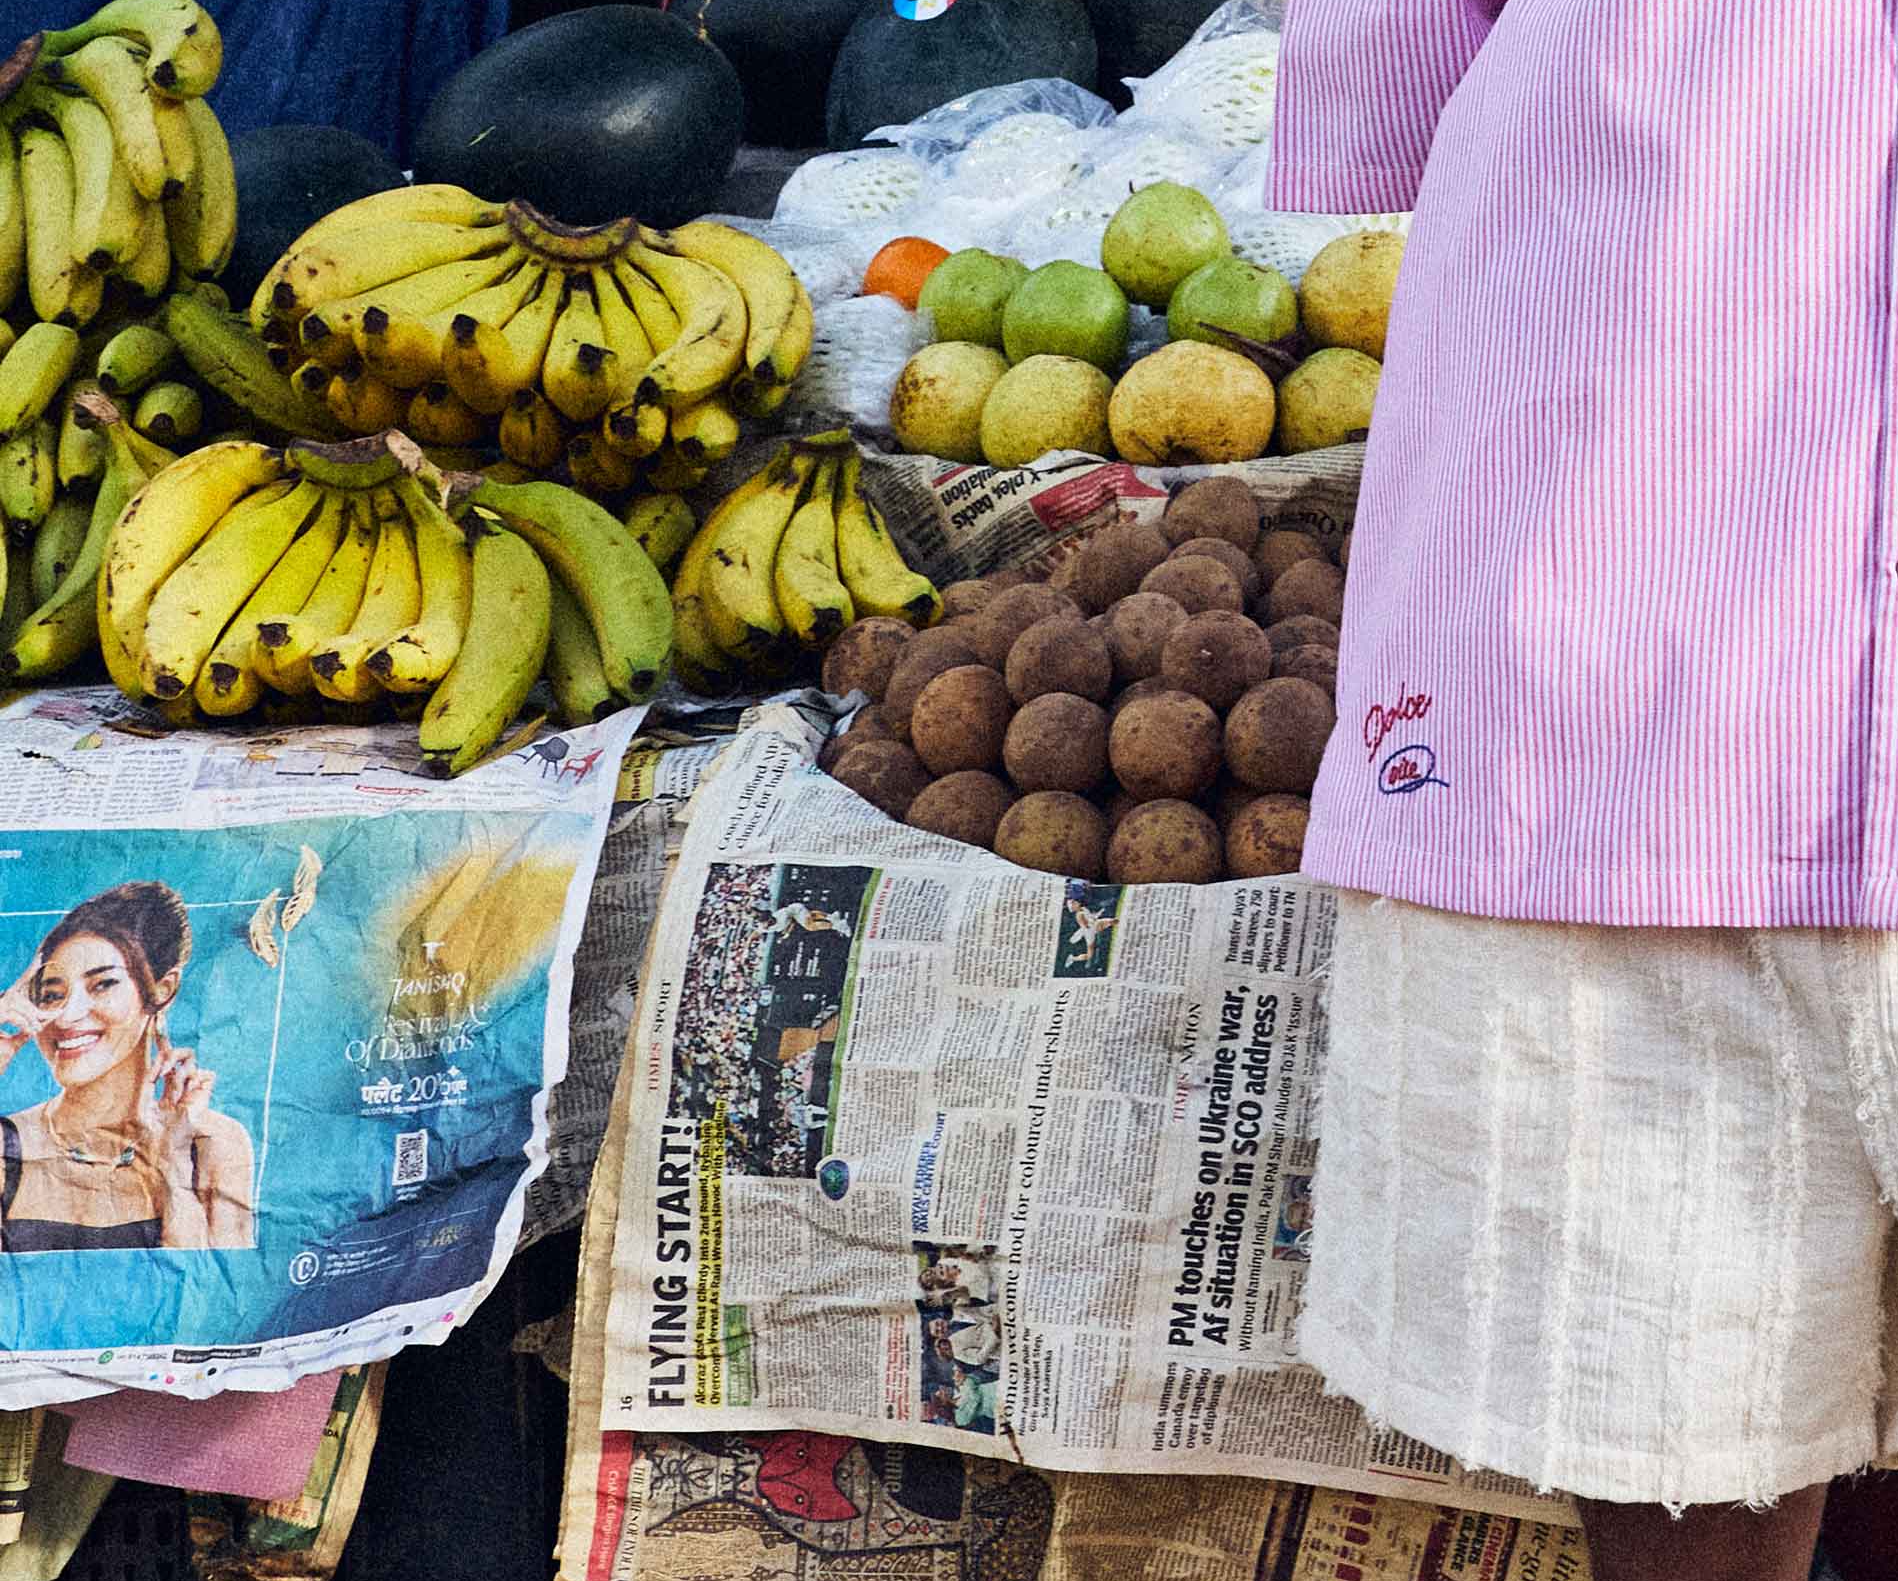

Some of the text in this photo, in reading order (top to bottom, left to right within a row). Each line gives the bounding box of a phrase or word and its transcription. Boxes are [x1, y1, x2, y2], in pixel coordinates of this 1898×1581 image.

[735, 811, 761, 850] choice
[755, 790, 773, 809] for
[764, 758, 789, 788] India
[1248, 890, 1263, 908] 750
[1224, 919, 1242, 963] Transfer
[1263, 918, 1276, 929] to
[1273, 891, 1296, 973] Petitioner to TN
[1256, 931, 1275, 974] slippers
[648, 978, 671, 1093] TIMES SPORT
[1034, 989, 1071, 1100] undershorts
[1282, 1033, 1298, 1059] J&K
[1172, 1002, 1201, 1122] TIMES NATION
[1279, 1060, 1293, 1073] To
[1273, 1074, 1292, 1121] Alludes
[1017, 1103, 1047, 1190] coloured
[1266, 1122, 1287, 1160] Sharif
[711, 1154, 723, 1180] With
[1168, 984, 1250, 1347] PM touches on Ukraine war,
[1202, 994, 1277, 1345] Af situation in SCO address
[1262, 1161, 1278, 1183] PM
[711, 1184, 721, 1217] Havoc
[1010, 1194, 1030, 1222] for
[1257, 1184, 1275, 1207] Pak
[699, 1216, 709, 1236] 2nd
[1007, 1227, 1028, 1265] nod
[649, 1123, 693, 1408] FLYING START!
[698, 1238, 709, 1261] Into
[696, 1264, 709, 1303] Chardy
[710, 1264, 721, 1289] Rain
[1245, 1248, 1266, 1299] Naming
[1003, 1269, 1020, 1355] welcome
[1238, 1300, 1258, 1352] Without
[620, 1395, 633, 1411] 16
[694, 1364, 706, 1405] Alcaraz
[1152, 1361, 1178, 1452] India summons
[1168, 1366, 1195, 1449] Canada envoy
[1185, 1367, 1211, 1449] over targeting
[1200, 1374, 1226, 1446] of diplomats
